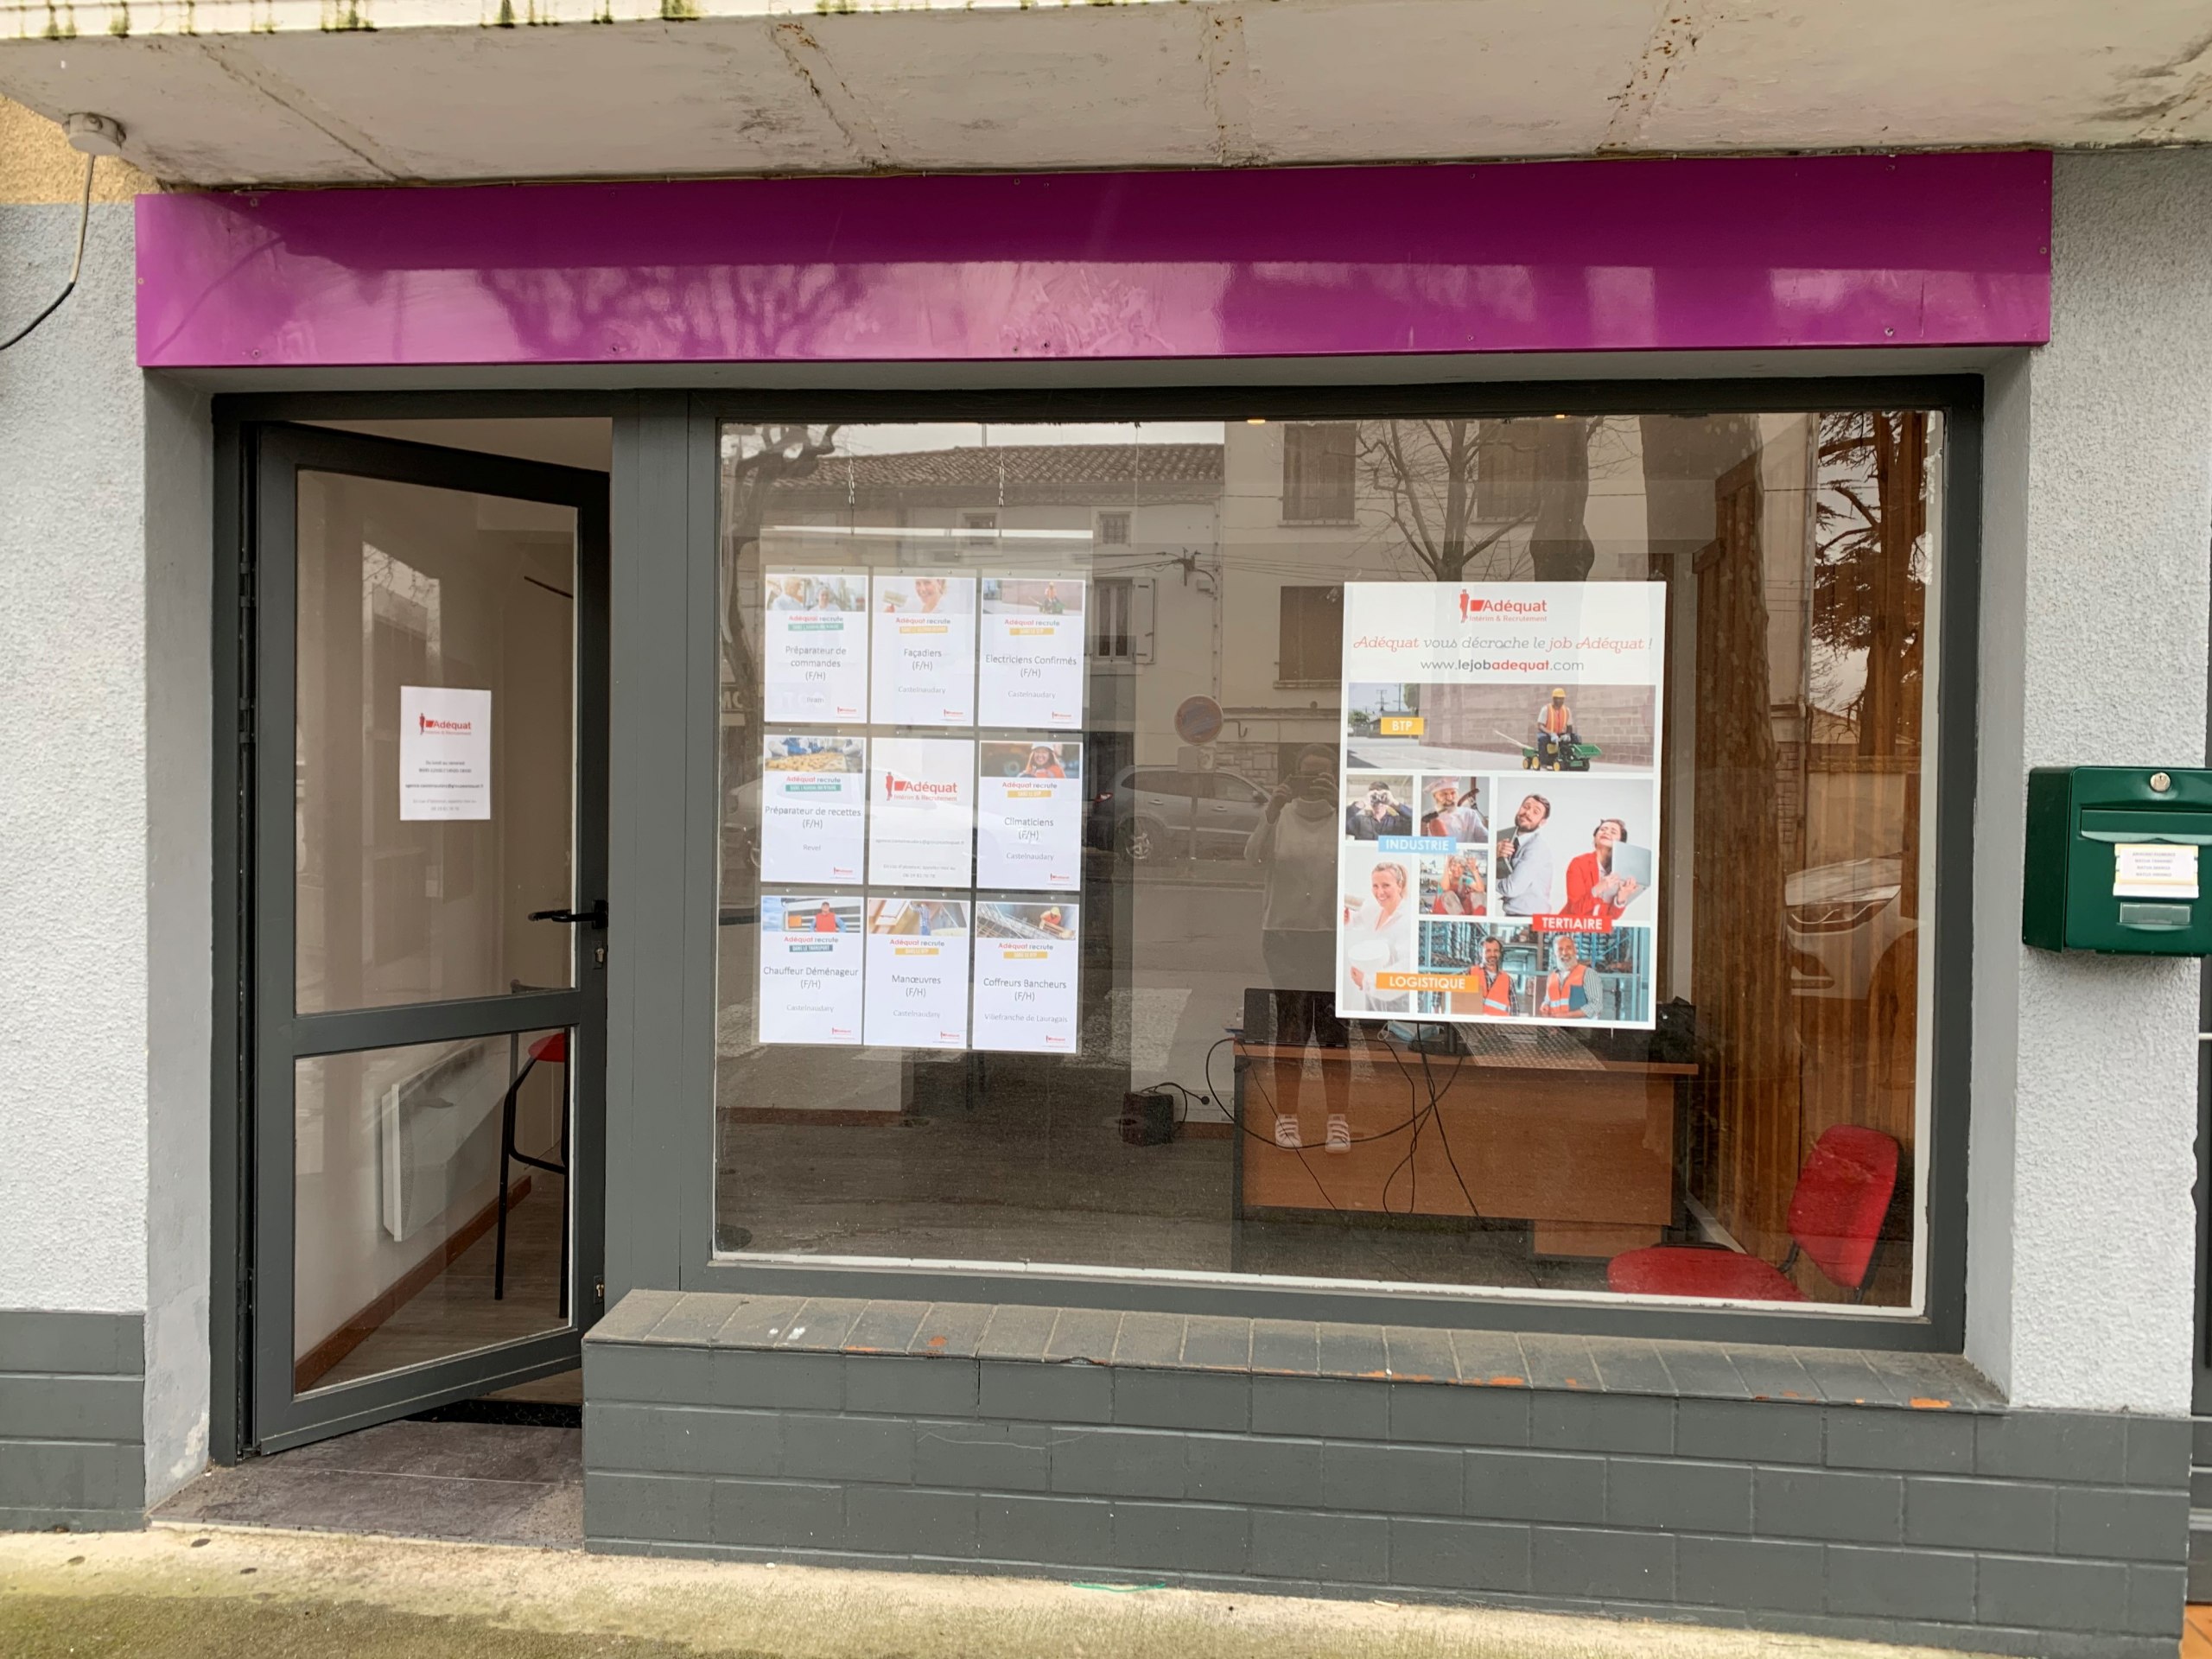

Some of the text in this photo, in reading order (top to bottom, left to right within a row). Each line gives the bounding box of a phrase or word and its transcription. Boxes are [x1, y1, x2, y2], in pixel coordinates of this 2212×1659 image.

[1483, 599, 1548, 616] Adéquat
[1353, 635, 1420, 652] Adéquat
[1423, 638, 1458, 650] vous
[1462, 636, 1529, 650] décroche
[1534, 637, 1547, 650] le
[1547, 637, 1573, 653] job
[1575, 636, 1644, 654] Adéquat
[785, 645, 847, 657] Préparateur de
[904, 647, 942, 658] Façadiers
[791, 658, 841, 668] commandes
[985, 654, 1077, 665] Electriciens Confirmés
[1420, 658, 1584, 672] www.lejobadequat.com
[912, 661, 932, 671] (F/H)
[805, 671, 826, 681] (F/H)
[1020, 667, 1041, 678] (F/H)
[898, 685, 946, 695] Castelnaudary
[1007, 690, 1056, 700] Castelnaudary
[434, 721, 471, 730] Adéquat
[1391, 720, 1413, 732] BTP
[905, 781, 957, 795] Adéquat
[765, 805, 861, 817] Préparateur de recettes
[802, 819, 823, 830] (F/H)
[1004, 817, 1053, 827] Climaticiens
[1018, 830, 1039, 841] (F/H)
[803, 843, 821, 852] Revel
[1385, 839, 1449, 851] INDUSTRIE
[1006, 852, 1054, 861] Castelnaudary
[1542, 918, 1603, 931] TERTIAIRE
[889, 938, 919, 947] Adéquat
[998, 942, 1028, 950] Adéquat
[763, 966, 858, 979] Chauffeur Déménageur
[800, 978, 821, 989] (F/H)
[892, 974, 941, 984] Manœuvres
[983, 977, 1067, 989] Coffreurs Bancheurs
[1389, 976, 1465, 989] LOGISTIQUE
[905, 987, 926, 998] (F/H)
[1014, 990, 1035, 1001] (F/H)
[786, 1004, 834, 1013] Castelnaudary
[893, 1009, 940, 1019] Castelnaudary
[984, 1013, 1024, 1021] Villefranche
[1036, 1014, 1068, 1024] Lauragais
